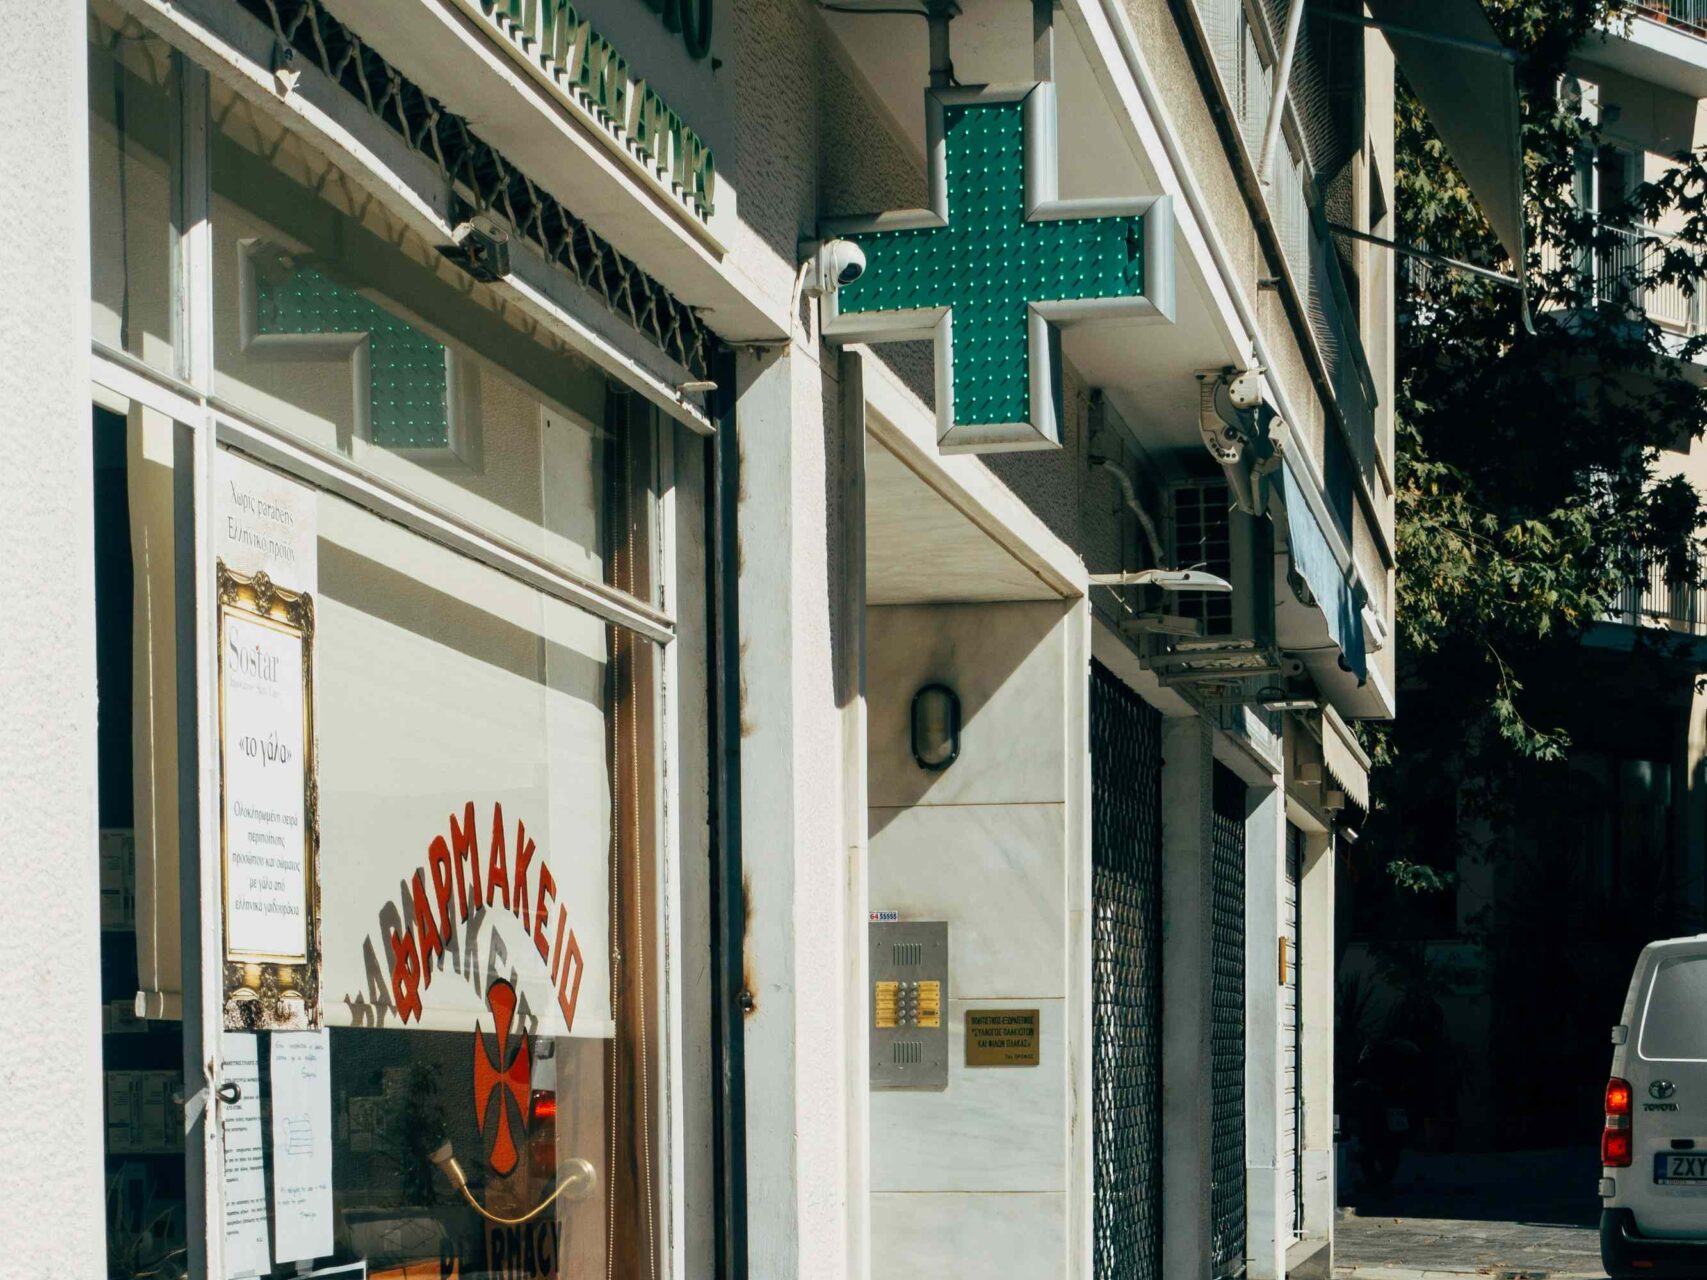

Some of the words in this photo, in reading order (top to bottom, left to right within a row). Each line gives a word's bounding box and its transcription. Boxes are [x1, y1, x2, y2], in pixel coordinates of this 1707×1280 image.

[230, 480, 255, 513] Χωρίς
[257, 498, 294, 527] parabens
[229, 625, 280, 683] Sostar
[391, 801, 584, 1034] ΦΑΡΜΑΚΕΙΟ
[1643, 1103, 1680, 1112] TOYOTA
